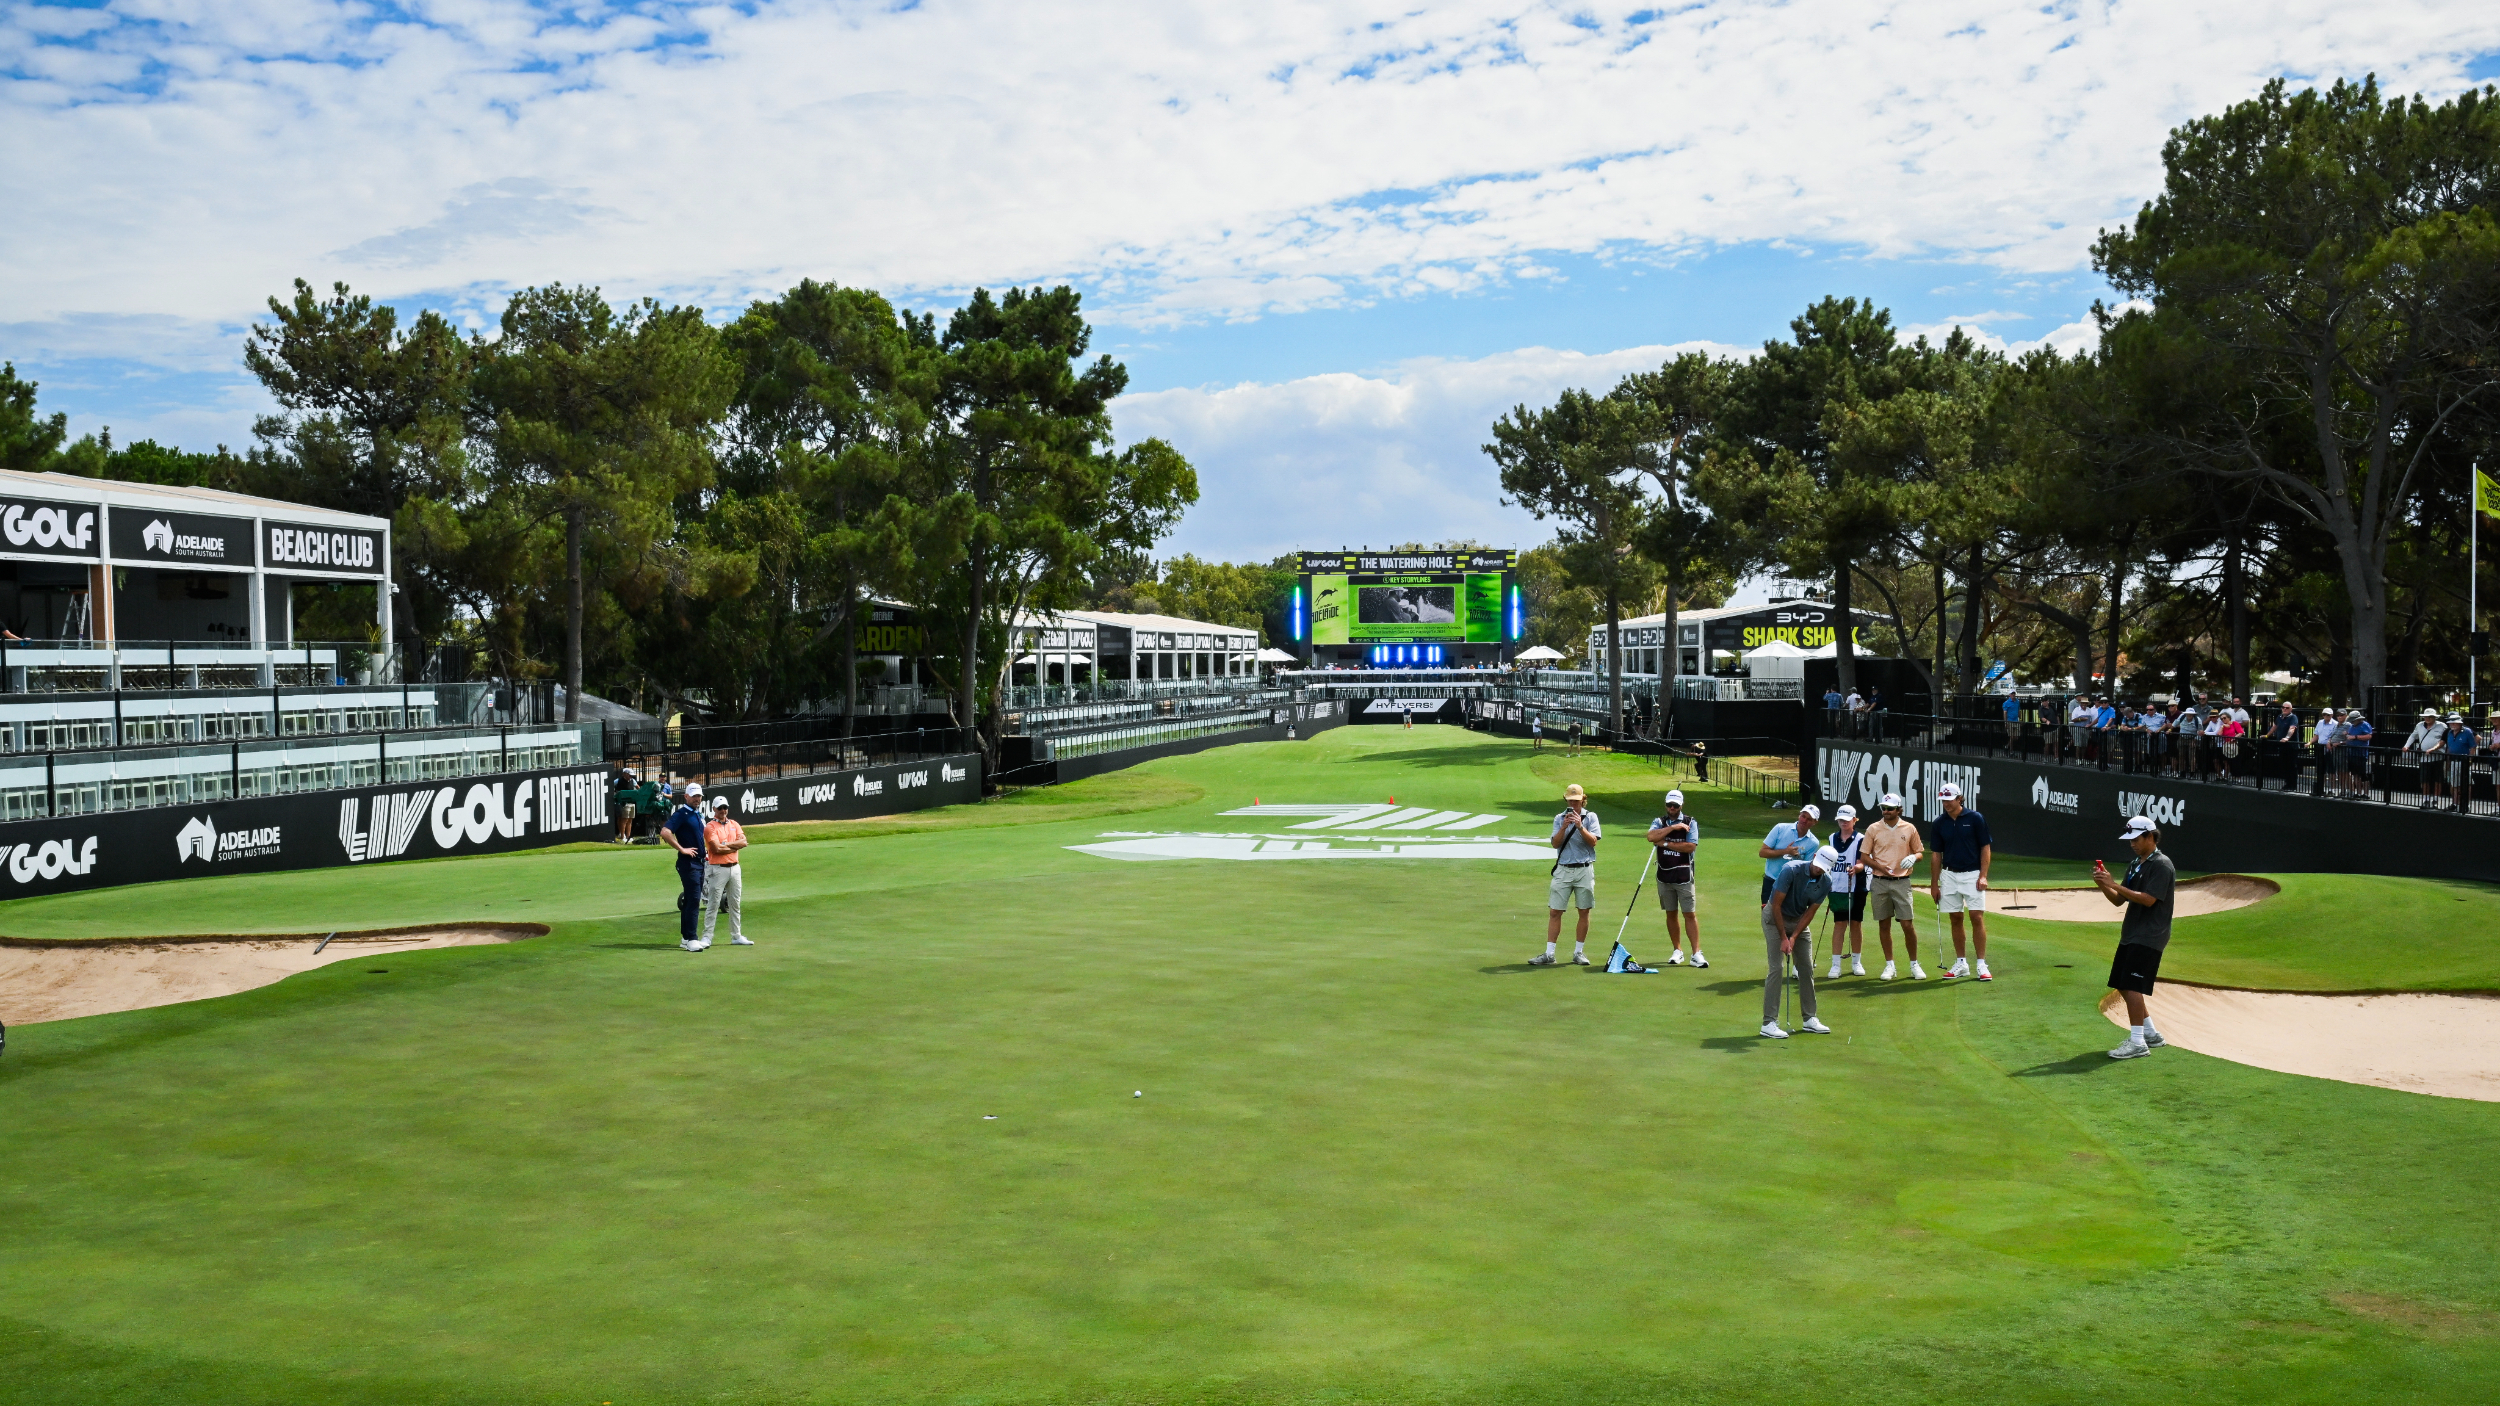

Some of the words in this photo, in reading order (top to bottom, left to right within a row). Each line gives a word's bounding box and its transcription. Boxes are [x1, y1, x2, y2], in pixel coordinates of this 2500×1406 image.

[3, 504, 94, 549] GOLF
[175, 534, 224, 551] ADELAIDE
[175, 548, 194, 556] SOUTH
[195, 549, 225, 558] AUSTRALIA
[271, 528, 329, 565] BEACH
[331, 533, 374, 568] CLUB
[1320, 559, 1341, 568] GOLF
[1359, 557, 1378, 569] THE
[1379, 557, 1428, 569] WATERING
[1428, 556, 1453, 569] HOLE
[1776, 612, 1825, 623] BYD
[855, 625, 923, 652] ARDEN
[1742, 626, 1800, 647] SHARK
[1802, 626, 1860, 647] SHAK
[910, 769, 928, 788] GOLF
[1817, 747, 1862, 804] LIV
[1858, 751, 1920, 819] GOLF
[755, 795, 779, 808] ADELAIDE
[798, 785, 816, 806] LIV
[814, 782, 836, 803] GOLF
[2049, 790, 2079, 808] ADELAIDE
[2118, 790, 2149, 818] LIV
[2146, 794, 2185, 827] GOLF
[339, 789, 435, 862] LIV
[430, 779, 533, 849] GOLF
[218, 826, 281, 851] ADELAIDE
[9, 835, 98, 884] GOLF
[217, 850, 242, 862] SOUTH
[243, 845, 281, 858] AUSTRALIA
